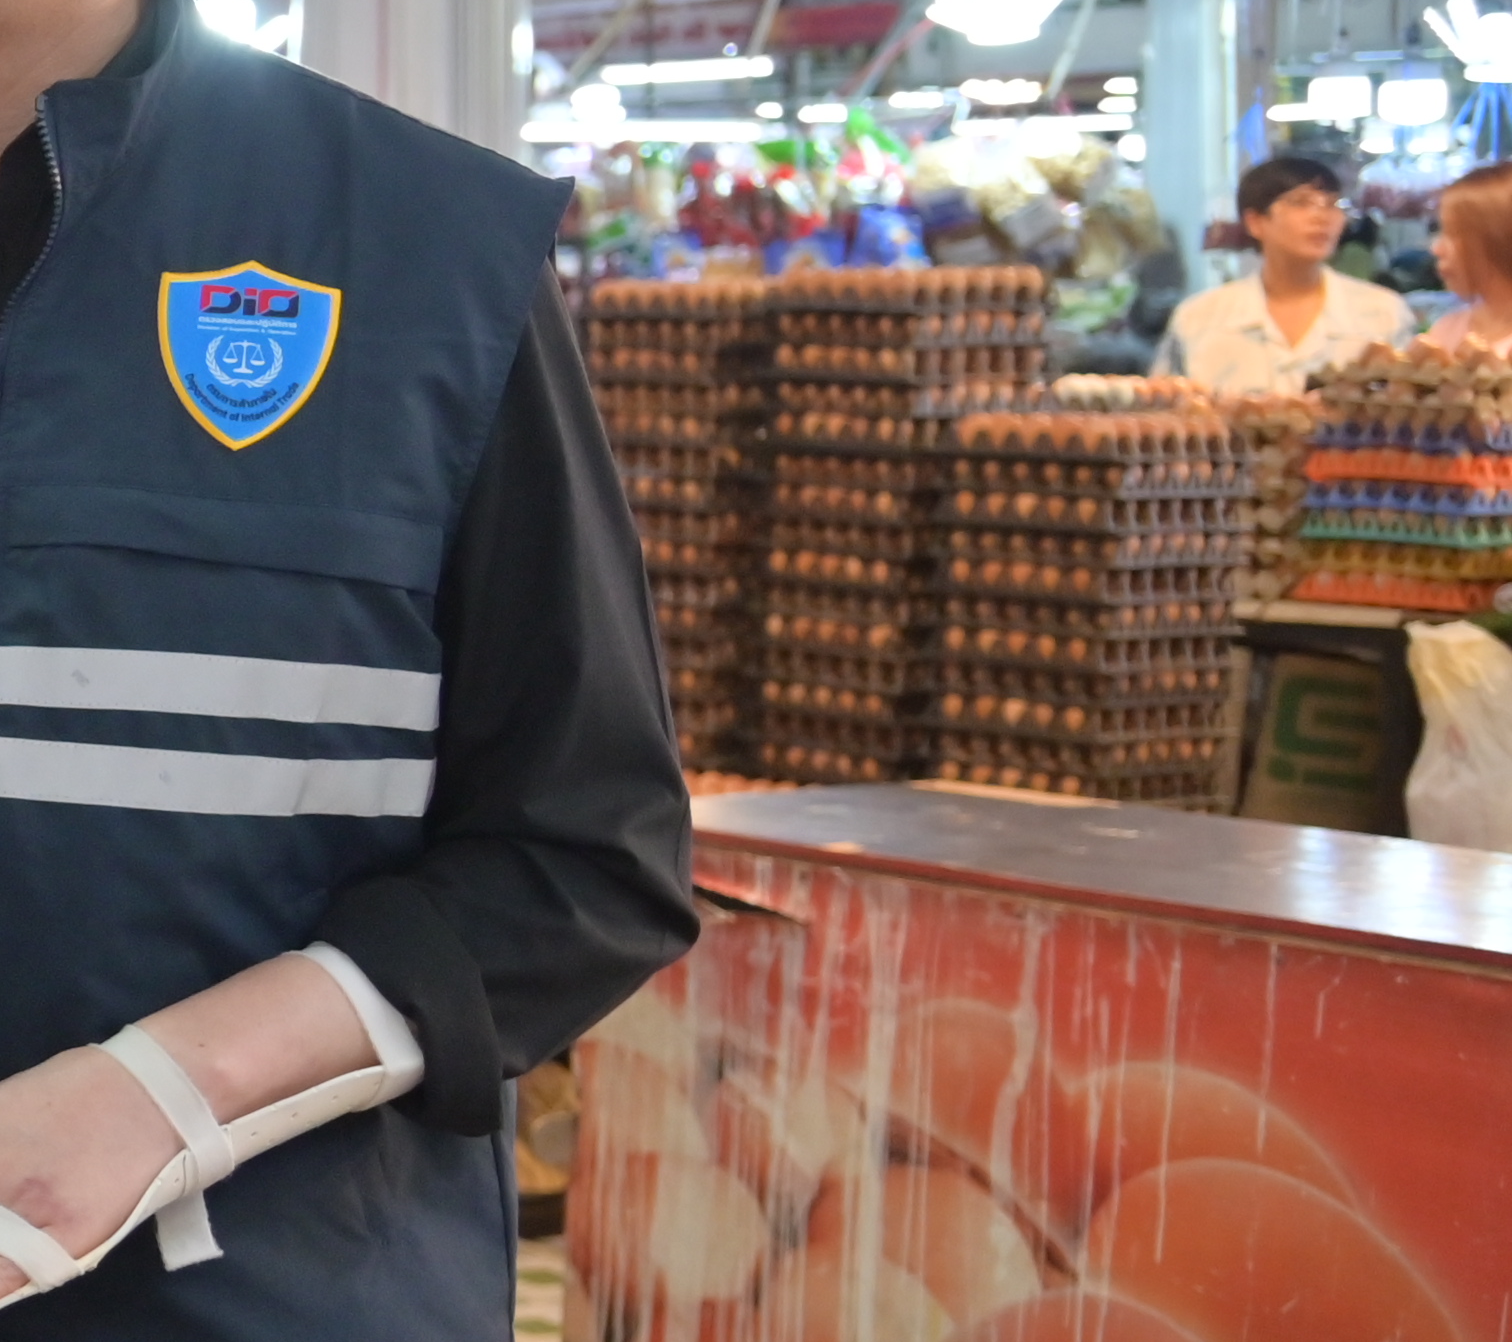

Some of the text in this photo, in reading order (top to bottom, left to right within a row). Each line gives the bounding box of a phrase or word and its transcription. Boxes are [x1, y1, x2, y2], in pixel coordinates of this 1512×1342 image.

[185, 373, 300, 422] Department of Internal Trade
